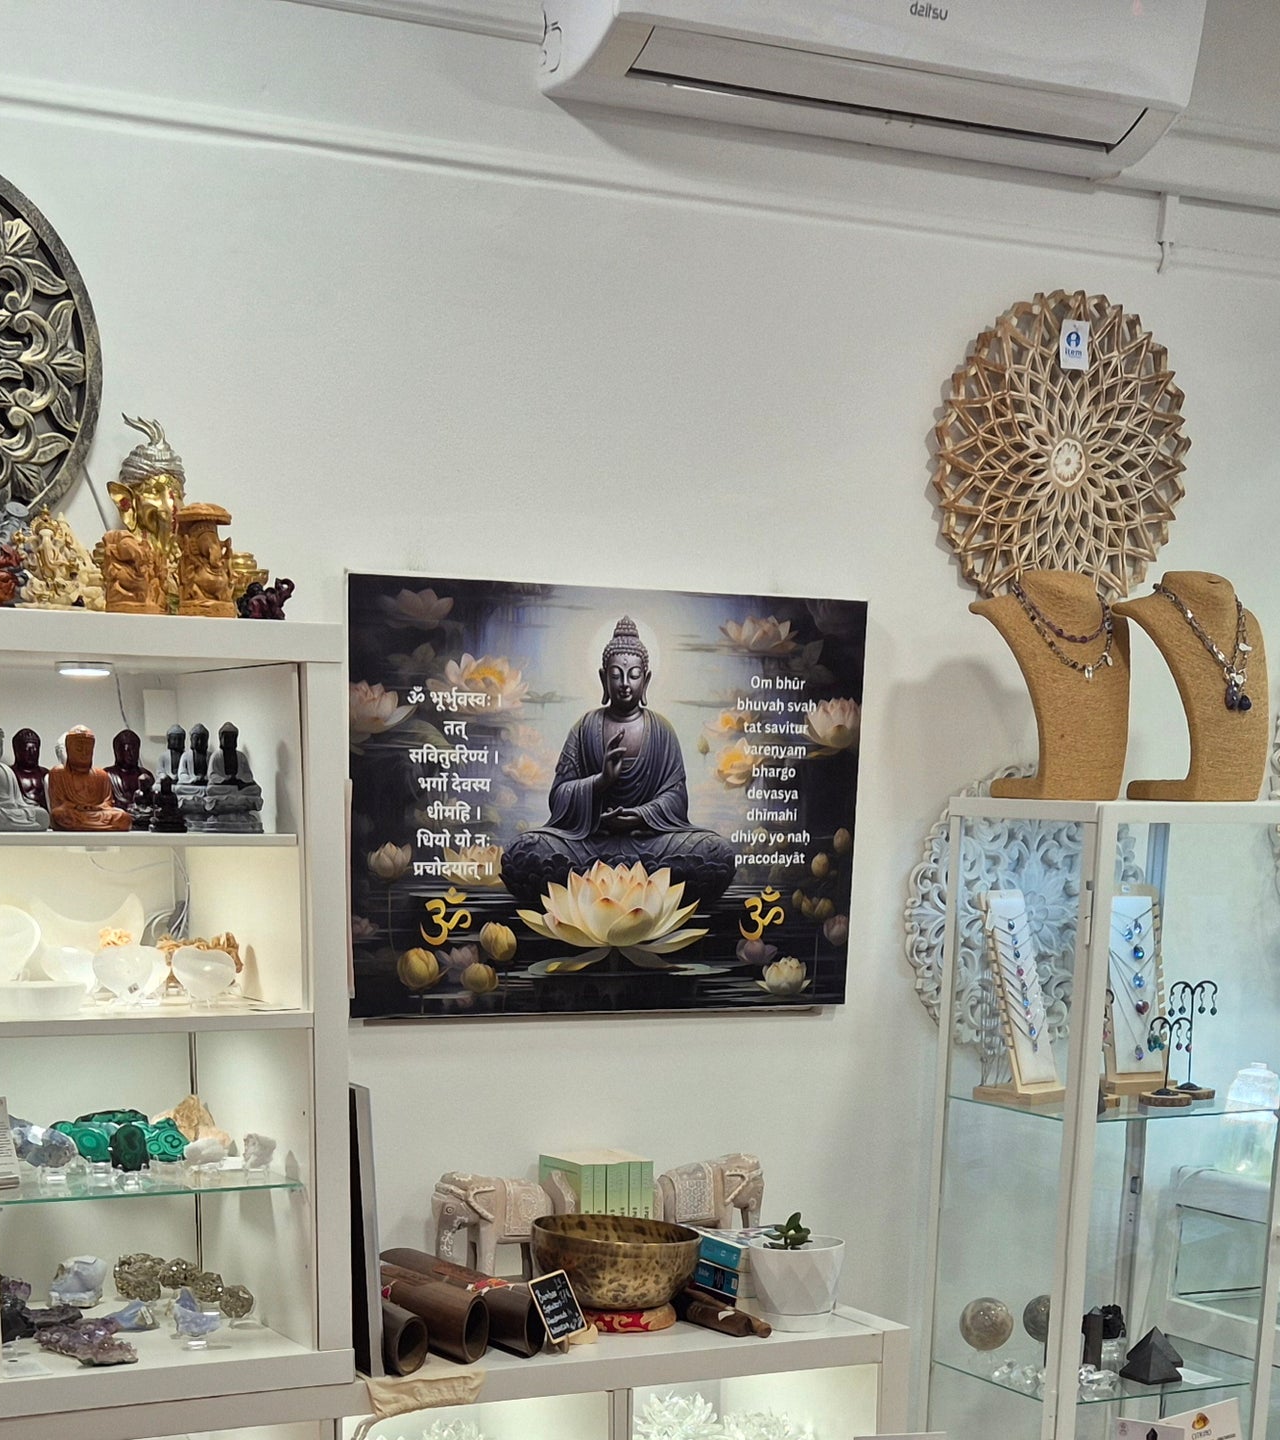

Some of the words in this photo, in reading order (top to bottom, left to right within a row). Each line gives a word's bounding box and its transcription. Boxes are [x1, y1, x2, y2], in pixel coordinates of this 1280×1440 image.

[910, 1, 948, 20] daitsu
[750, 675, 772, 690] Om
[775, 675, 806, 691] bhūr
[407, 686, 425, 704] ॐ
[736, 697, 785, 715] bhuvaḥ
[787, 699, 817, 716] svaḥ
[443, 720, 469, 741] तत्
[743, 721, 762, 734] tat
[764, 720, 809, 735] savitur
[751, 763, 797, 781] bhargo
[450, 772, 492, 793] देवस्य
[747, 786, 799, 804] devasya
[426, 800, 472, 823] धीमहि
[416, 828, 451, 848] धियो
[454, 828, 472, 848] यो
[730, 829, 767, 847] dhiyo
[768, 832, 786, 847] yo
[787, 829, 811, 846] naḥ
[412, 855, 482, 881] प्रचोदयात्
[734, 850, 806, 869] pracodayāt
